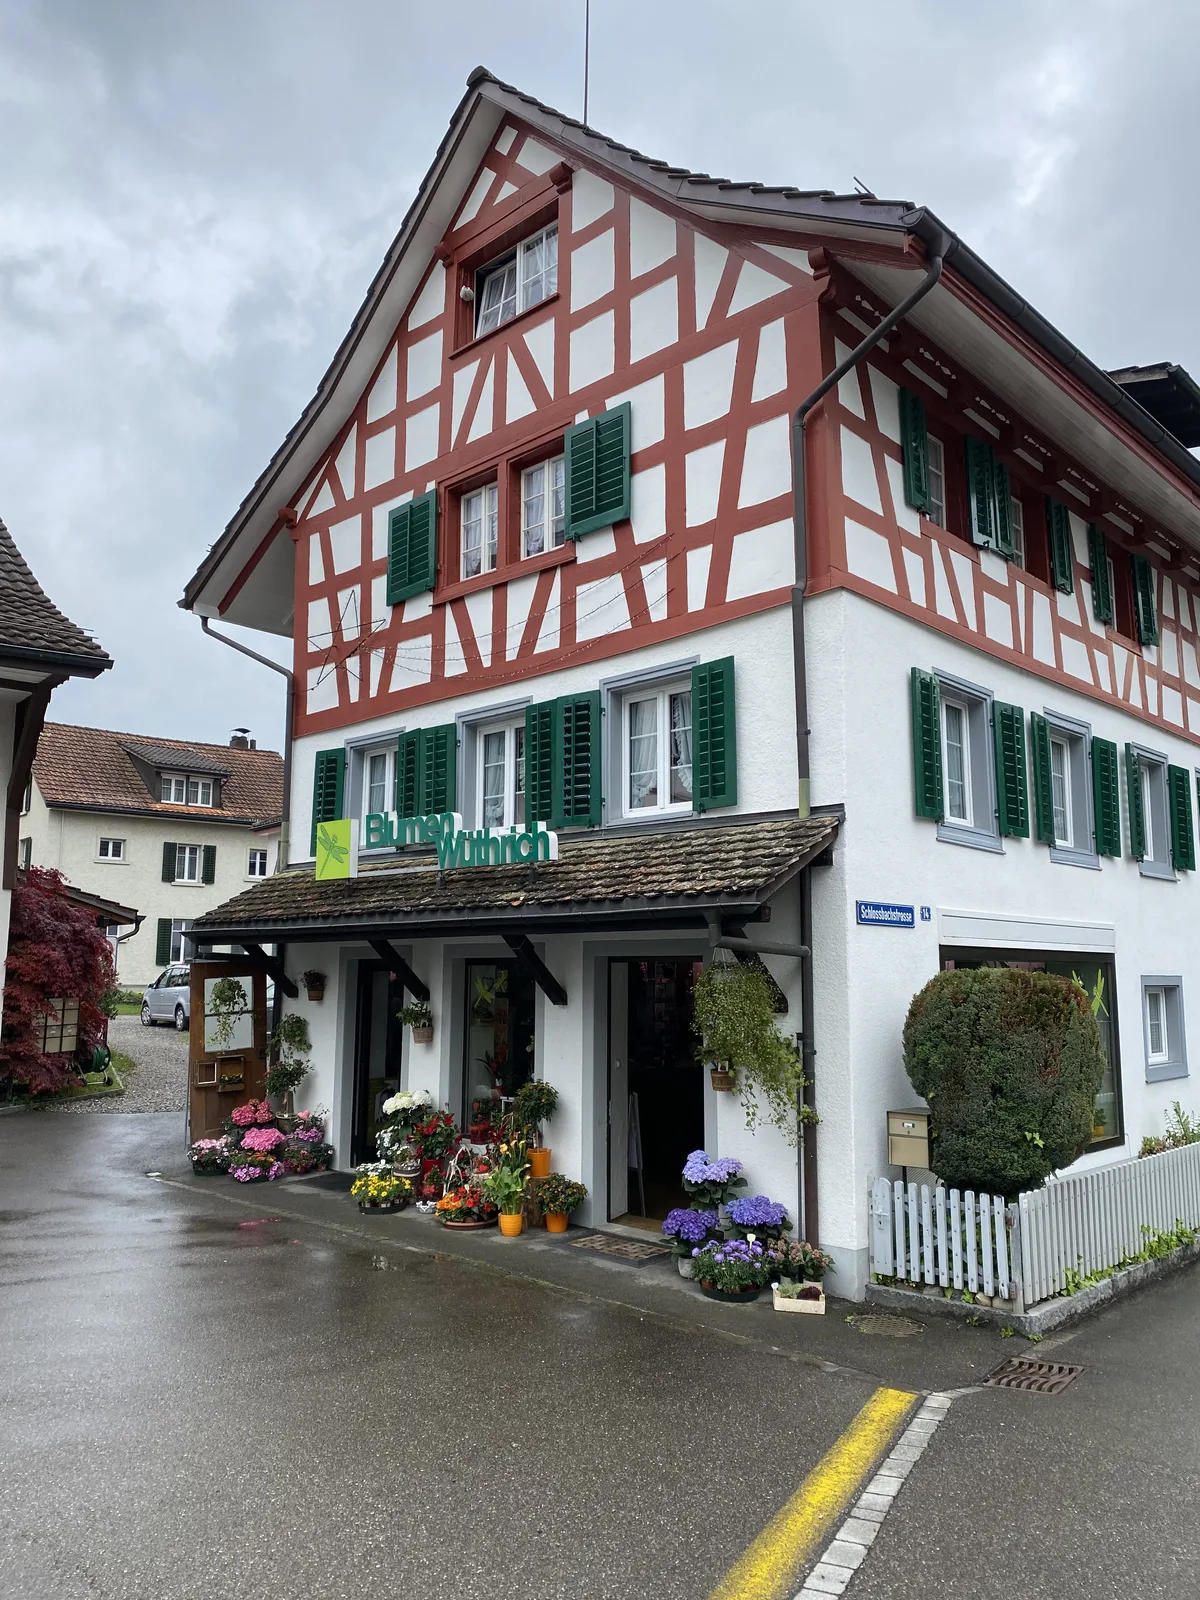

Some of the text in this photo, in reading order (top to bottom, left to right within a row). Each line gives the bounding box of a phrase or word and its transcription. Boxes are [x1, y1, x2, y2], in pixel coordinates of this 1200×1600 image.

[366, 811, 458, 850] Blumen
[436, 820, 553, 869] Wüthrich
[861, 904, 913, 923] Schlossbachstrasse
[922, 908, 930, 919] 14
